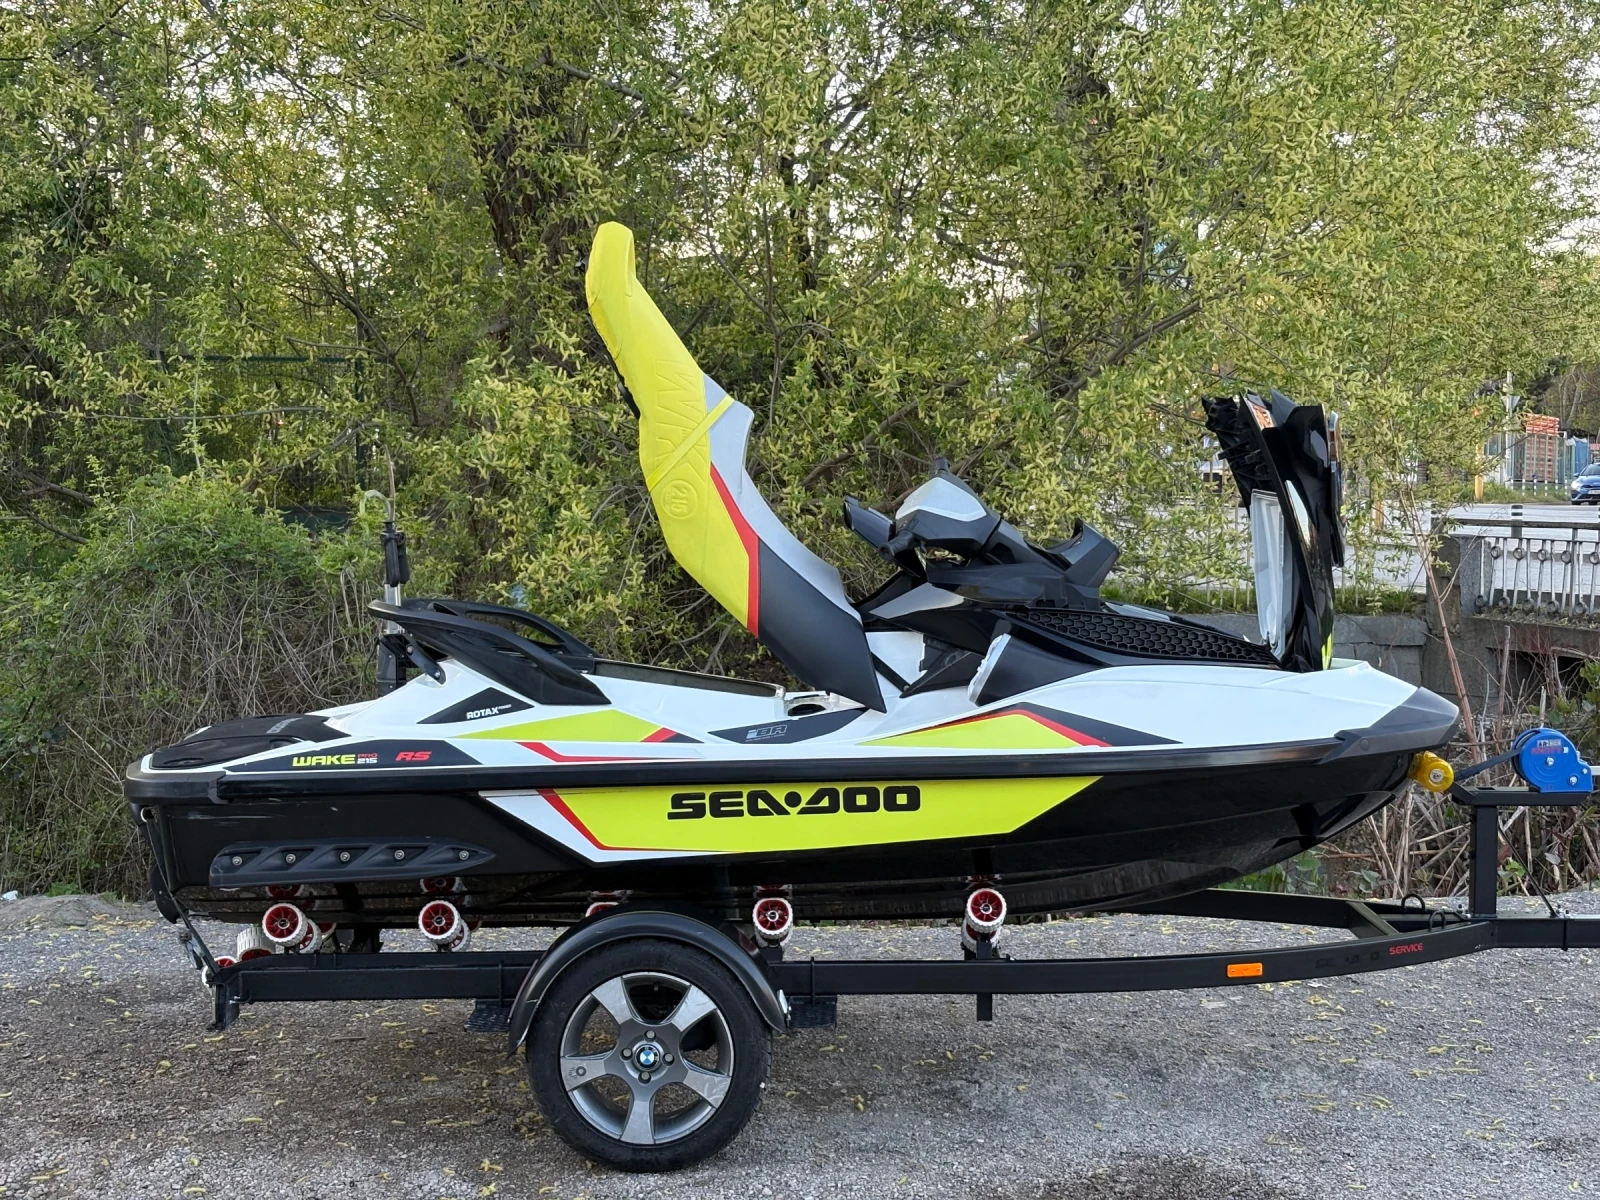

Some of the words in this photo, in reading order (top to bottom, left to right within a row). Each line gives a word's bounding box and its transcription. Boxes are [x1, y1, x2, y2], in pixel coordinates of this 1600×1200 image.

[670, 487, 688, 513] 215
[466, 706, 499, 719] ROTAX
[292, 754, 355, 767] WAKE
[395, 751, 432, 761] RS
[1389, 943, 1423, 955] SERVICE
